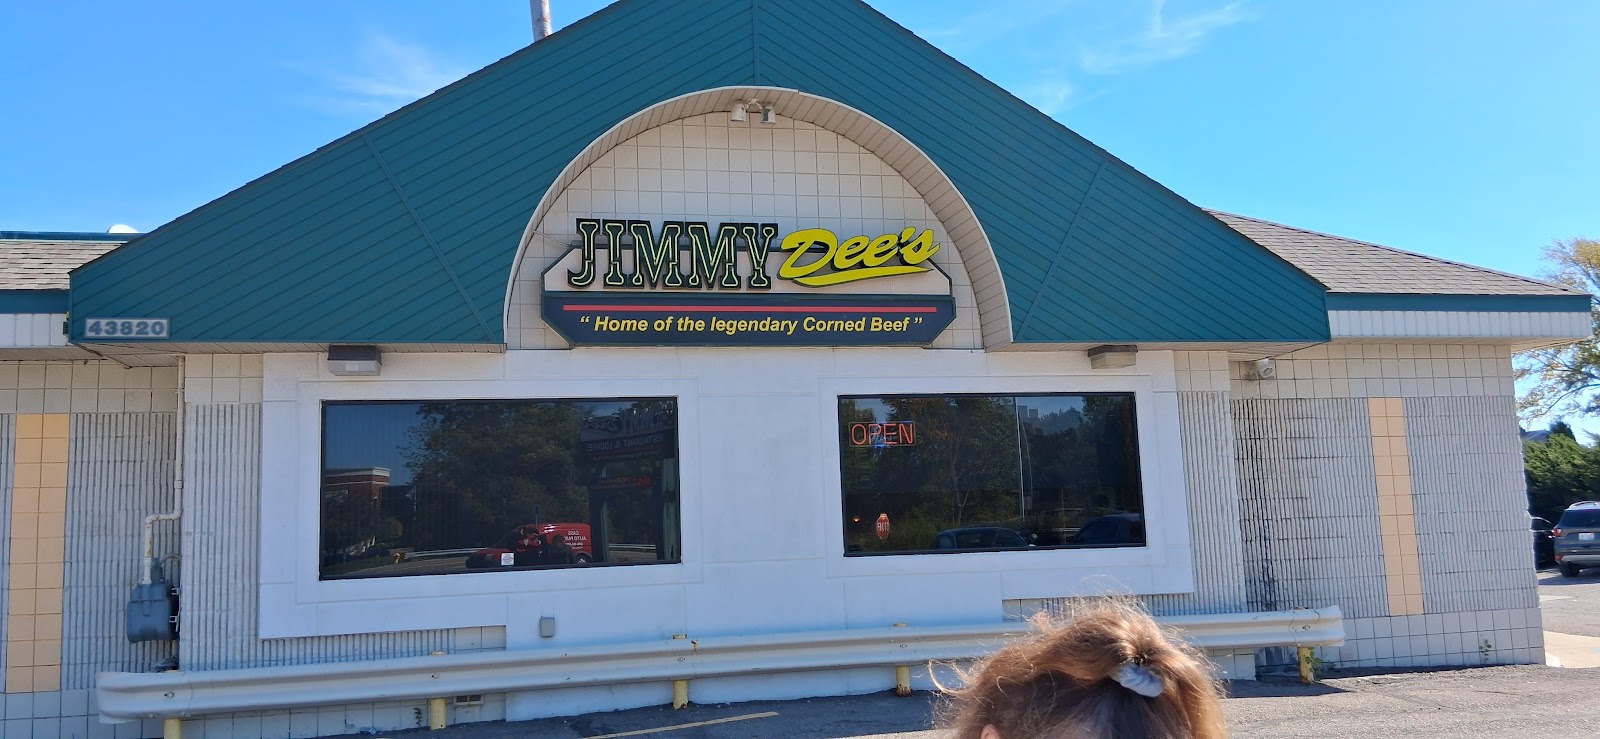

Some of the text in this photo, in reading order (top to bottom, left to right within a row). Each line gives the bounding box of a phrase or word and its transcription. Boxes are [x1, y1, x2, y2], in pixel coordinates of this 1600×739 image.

[566, 218, 941, 290] JIMMY Dee's
[88, 321, 165, 336] 43820
[653, 317, 674, 331] of
[677, 317, 706, 331] the
[710, 317, 798, 335] legendary
[803, 317, 866, 331] Corned
[851, 423, 914, 445] OPEN
